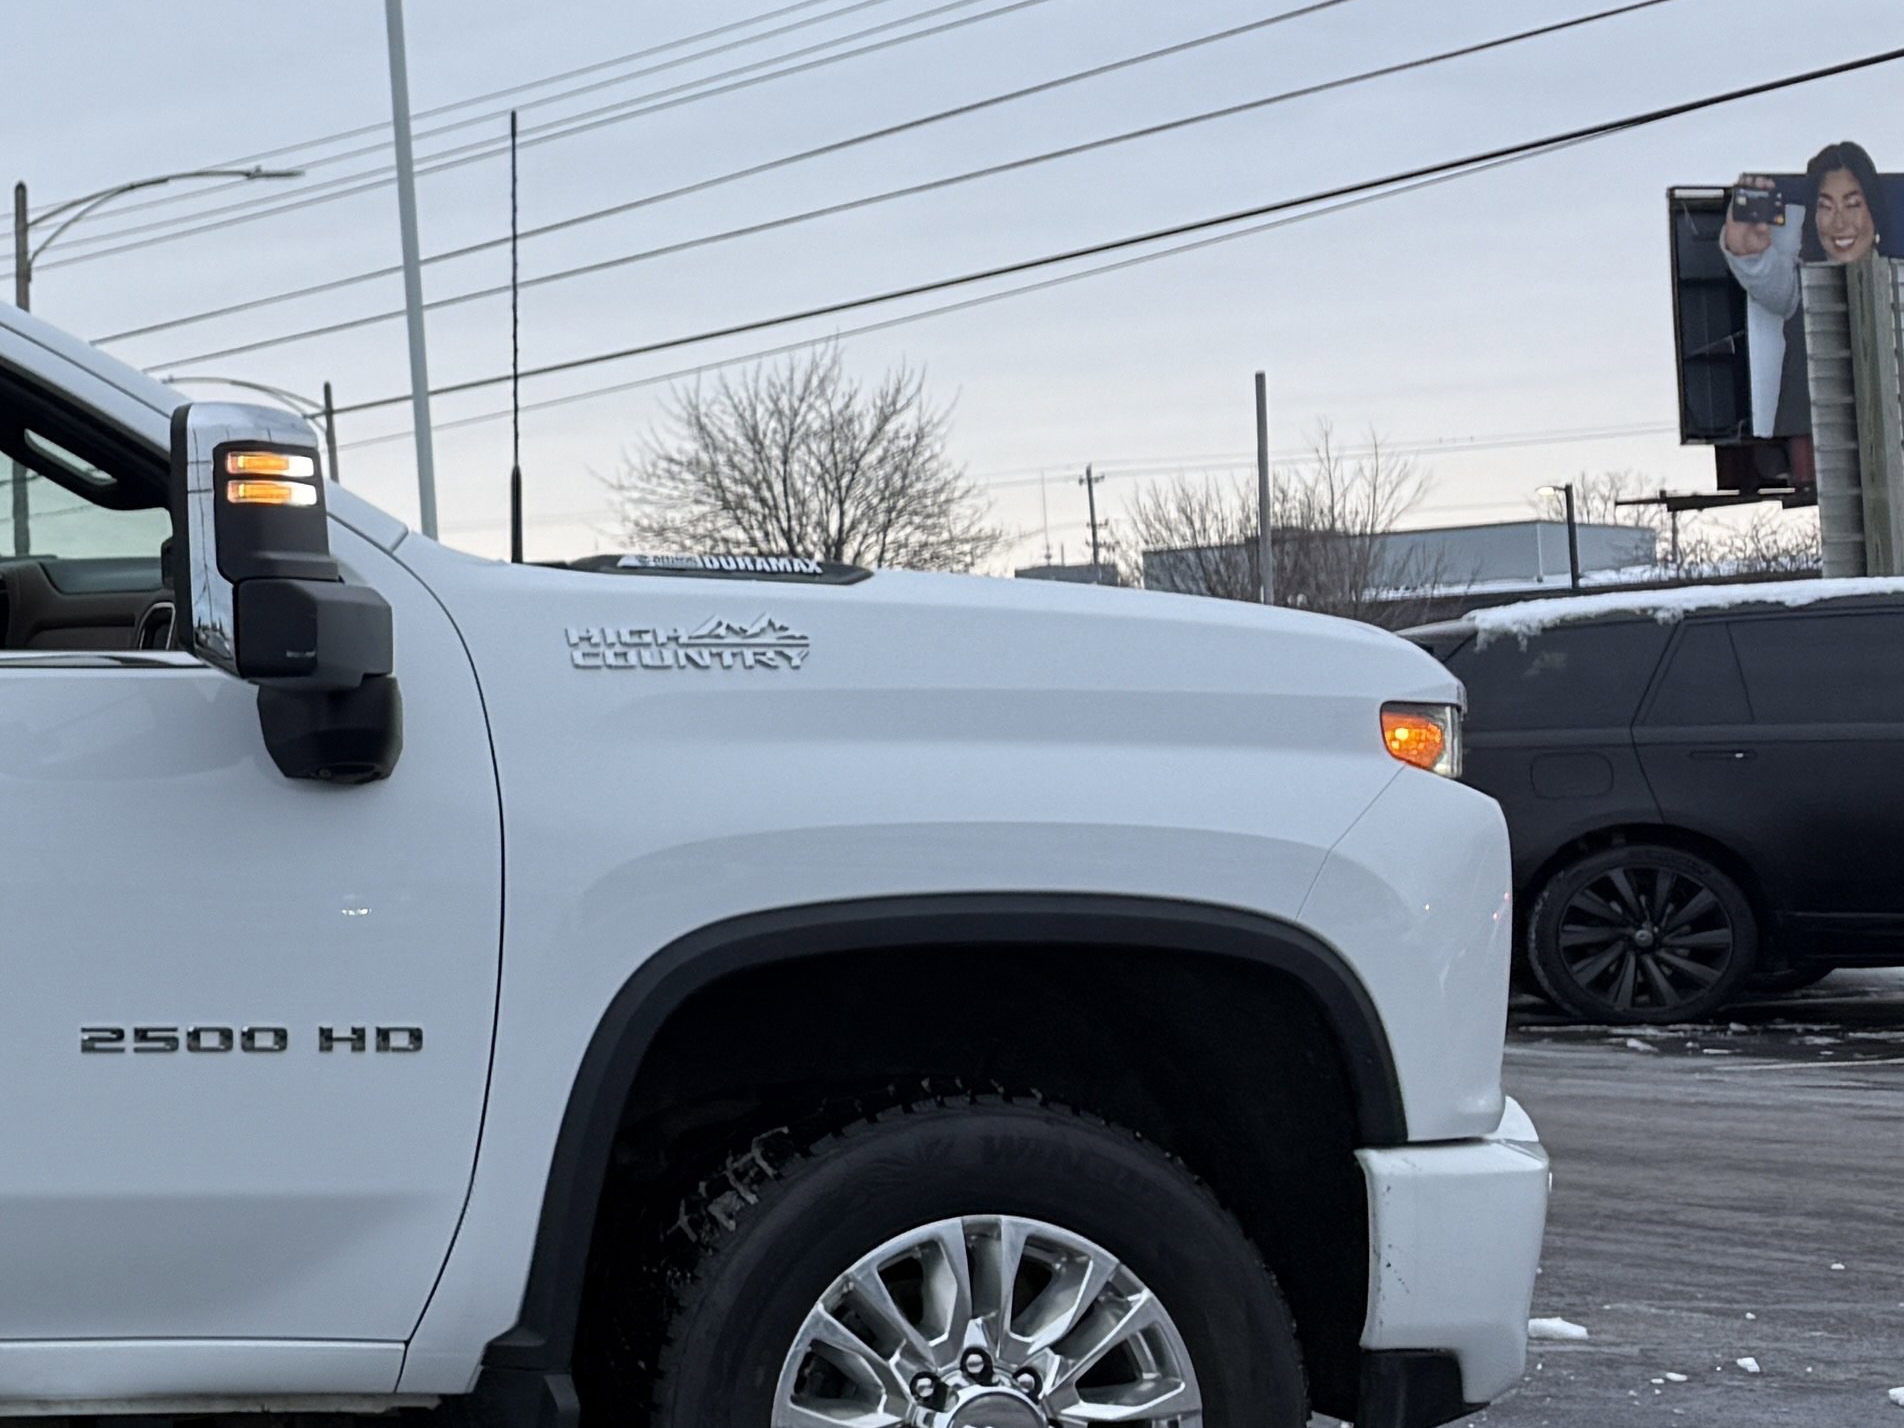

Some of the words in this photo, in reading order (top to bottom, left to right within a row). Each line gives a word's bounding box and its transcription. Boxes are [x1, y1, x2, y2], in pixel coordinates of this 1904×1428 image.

[703, 555, 824, 574] DURAMAX
[565, 627, 690, 648] HIGH
[571, 649, 810, 670] COUNTRY
[80, 1025, 289, 1054] 2500
[318, 1025, 424, 1054] HD
